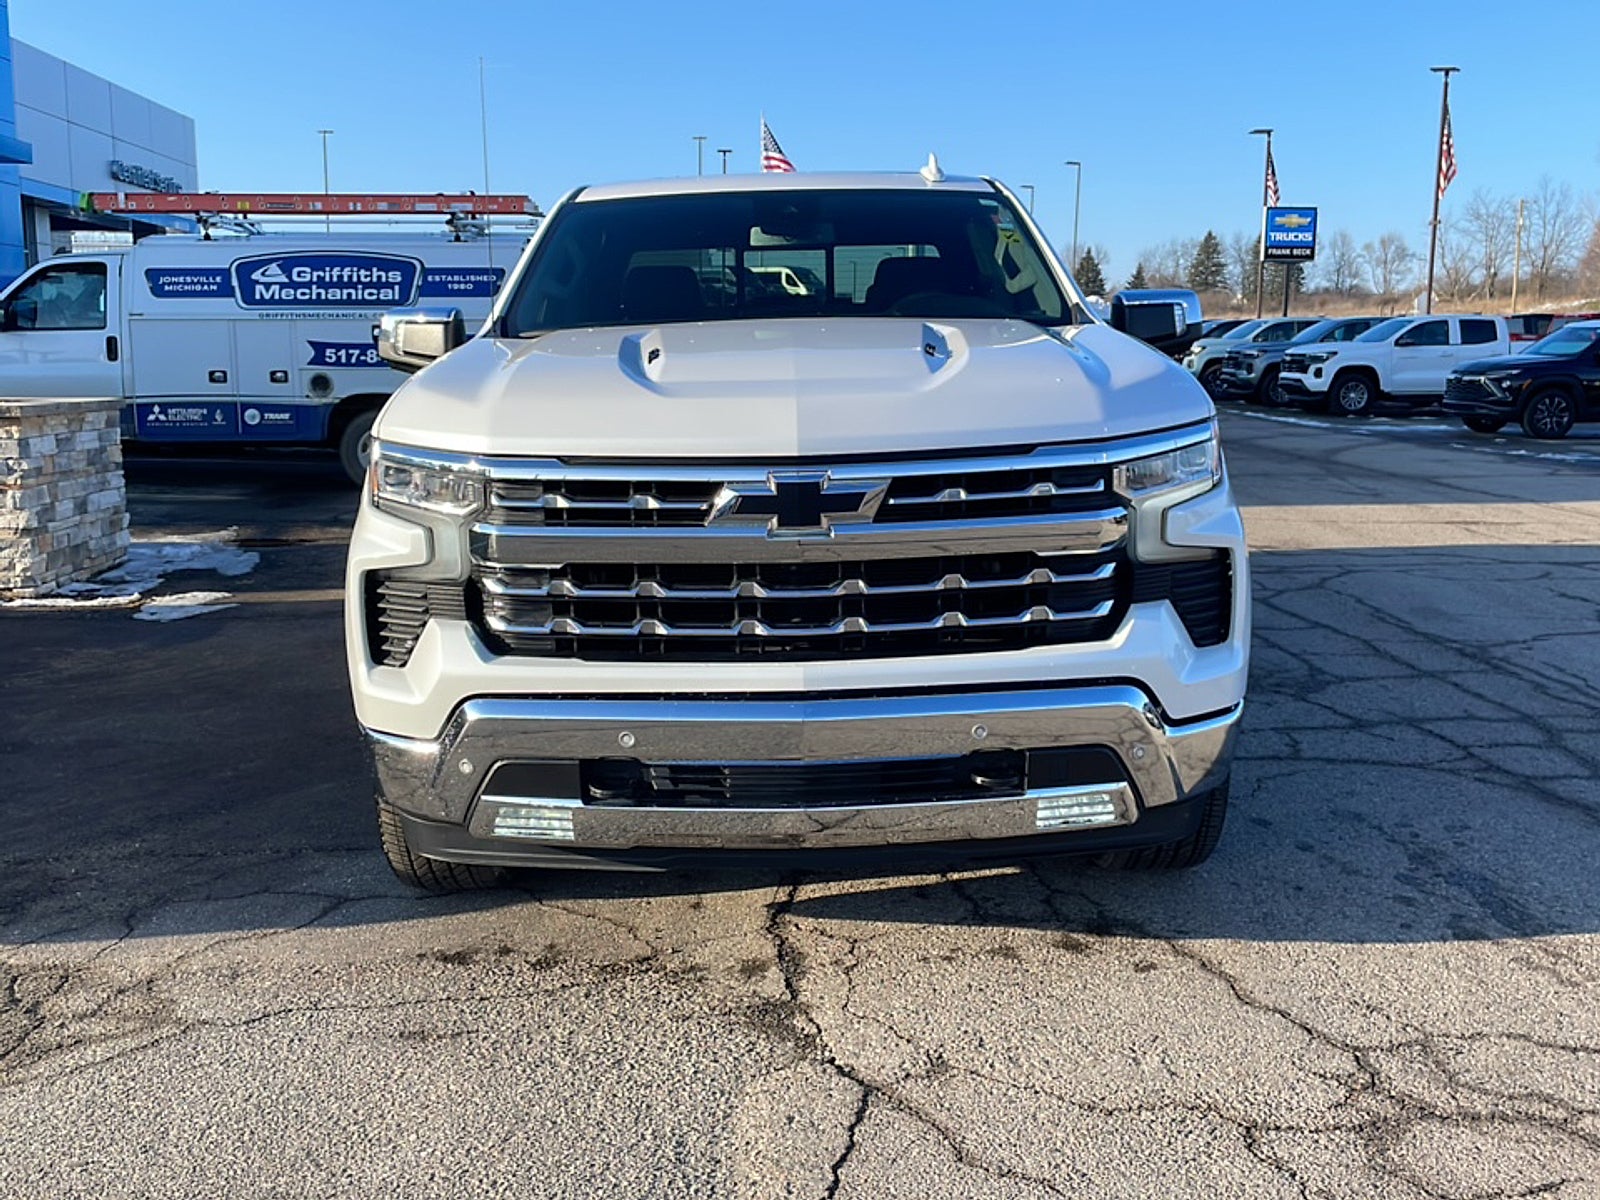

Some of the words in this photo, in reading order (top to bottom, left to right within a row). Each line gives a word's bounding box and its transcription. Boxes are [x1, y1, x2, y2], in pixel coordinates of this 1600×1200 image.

[1269, 232, 1312, 241] TRUCKS
[291, 266, 402, 283] Griffiths
[427, 274, 497, 283] ESTABLISHED
[158, 275, 223, 285] JONESVILLE
[163, 284, 218, 292] MICHIGAN
[254, 284, 400, 301] Mechanical
[324, 348, 382, 364] 517-8
